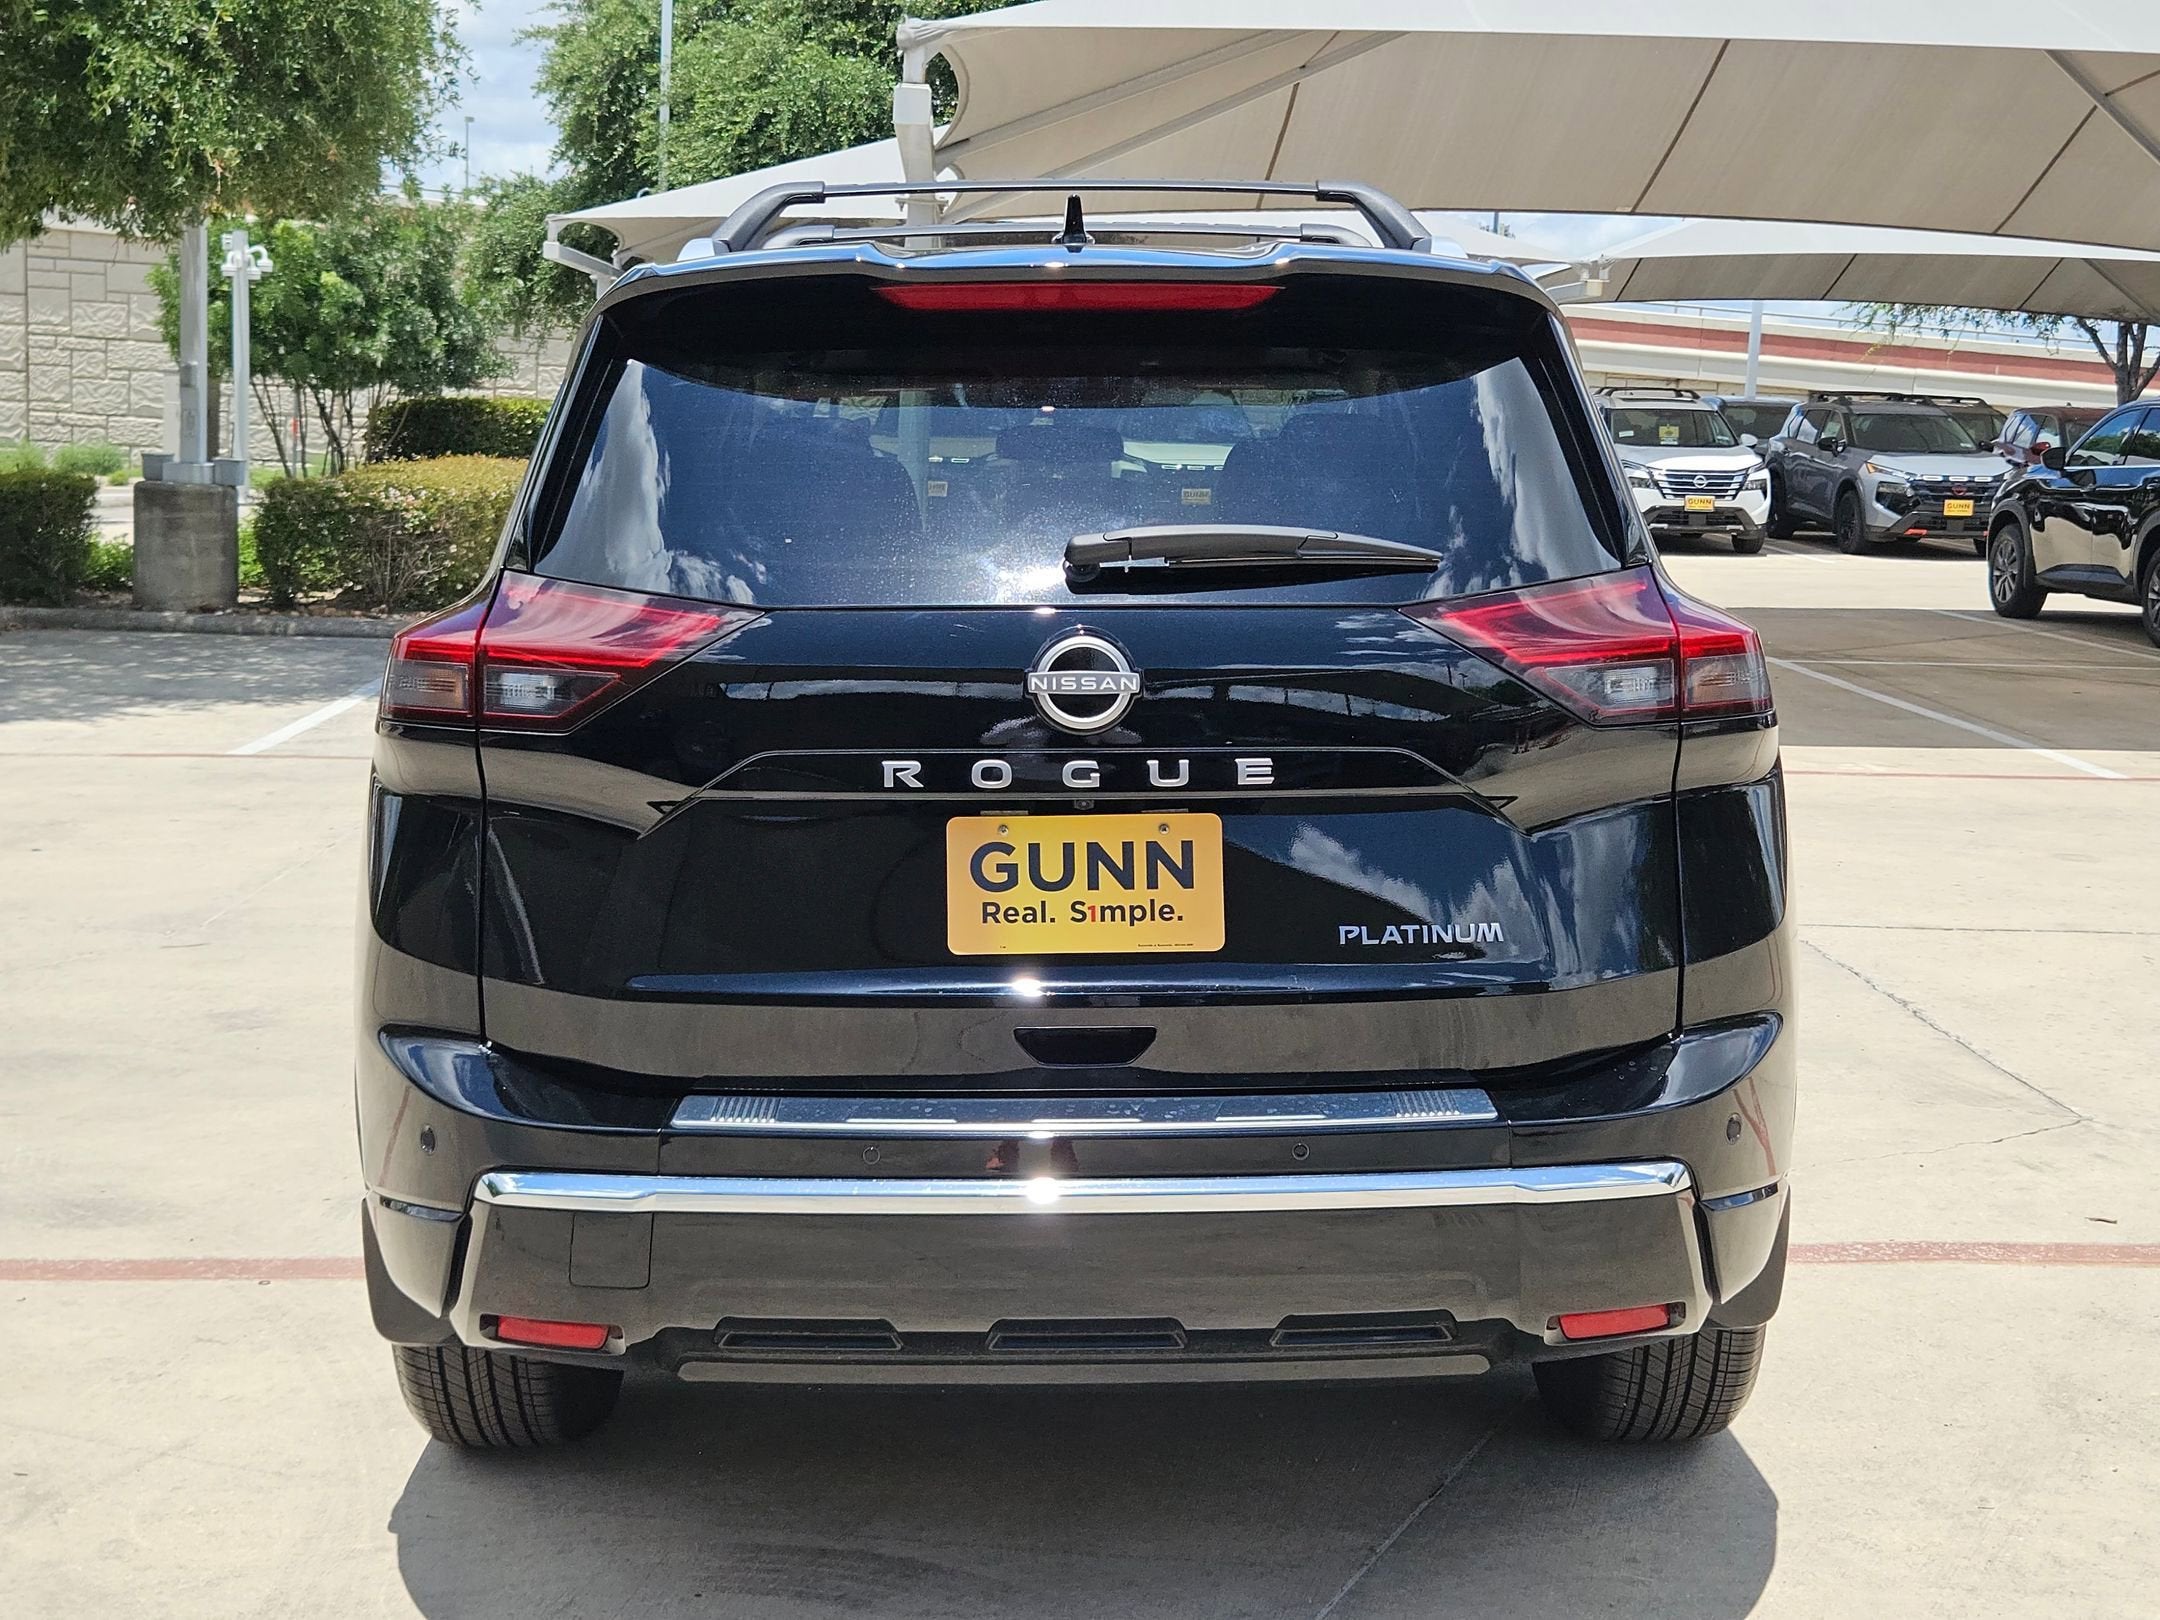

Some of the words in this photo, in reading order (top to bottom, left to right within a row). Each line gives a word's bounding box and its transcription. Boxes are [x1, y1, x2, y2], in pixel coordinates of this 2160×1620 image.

[1946, 502, 1970, 510] GUNN
[1030, 673, 1139, 692] NISSAN
[882, 757, 1276, 789] ROGUE
[969, 839, 1195, 893] GUNN
[981, 901, 1057, 925] Real.
[1338, 922, 1505, 945] PLATINUM
